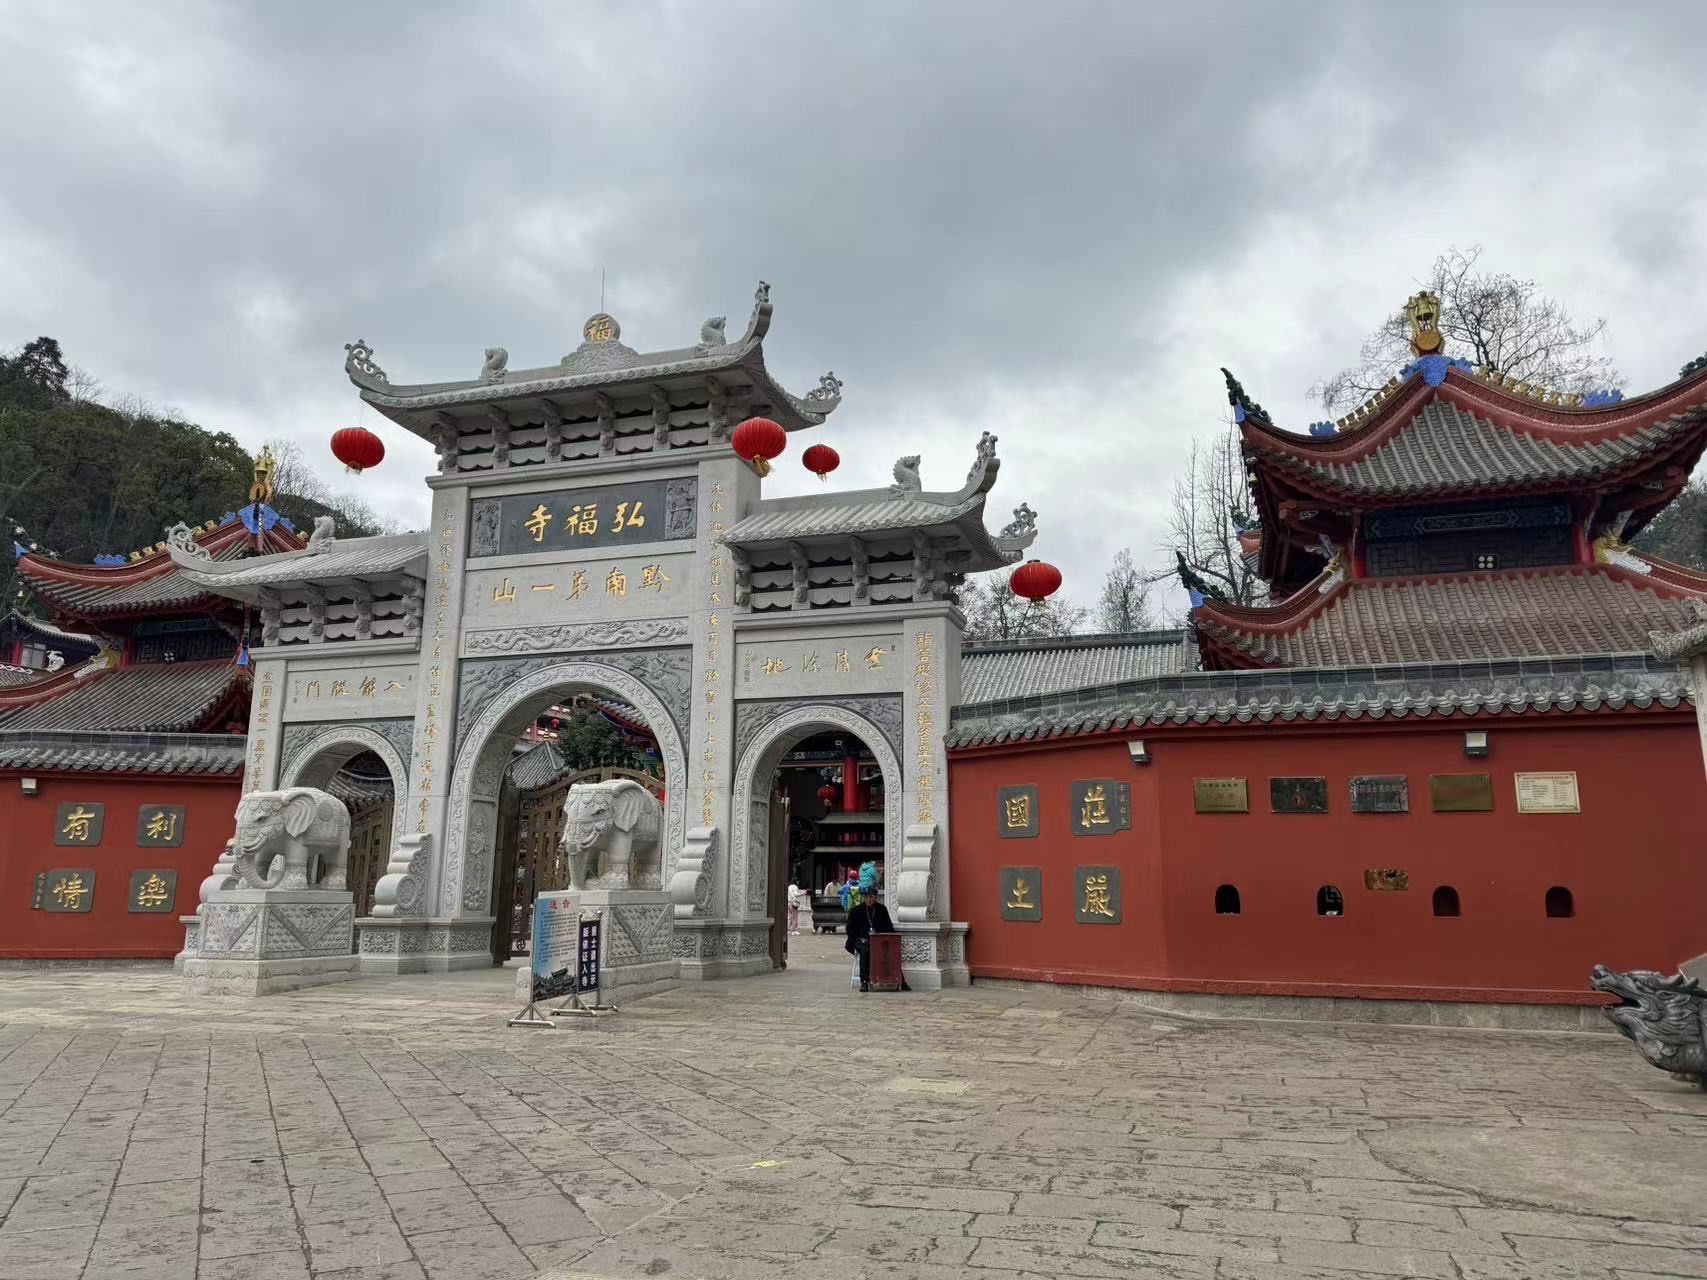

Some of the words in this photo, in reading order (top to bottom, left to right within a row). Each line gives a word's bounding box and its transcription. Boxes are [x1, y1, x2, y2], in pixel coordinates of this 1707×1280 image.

[585, 315, 611, 342] 福
[523, 501, 646, 542] 弘福寺
[492, 564, 671, 602] 黔南第一山
